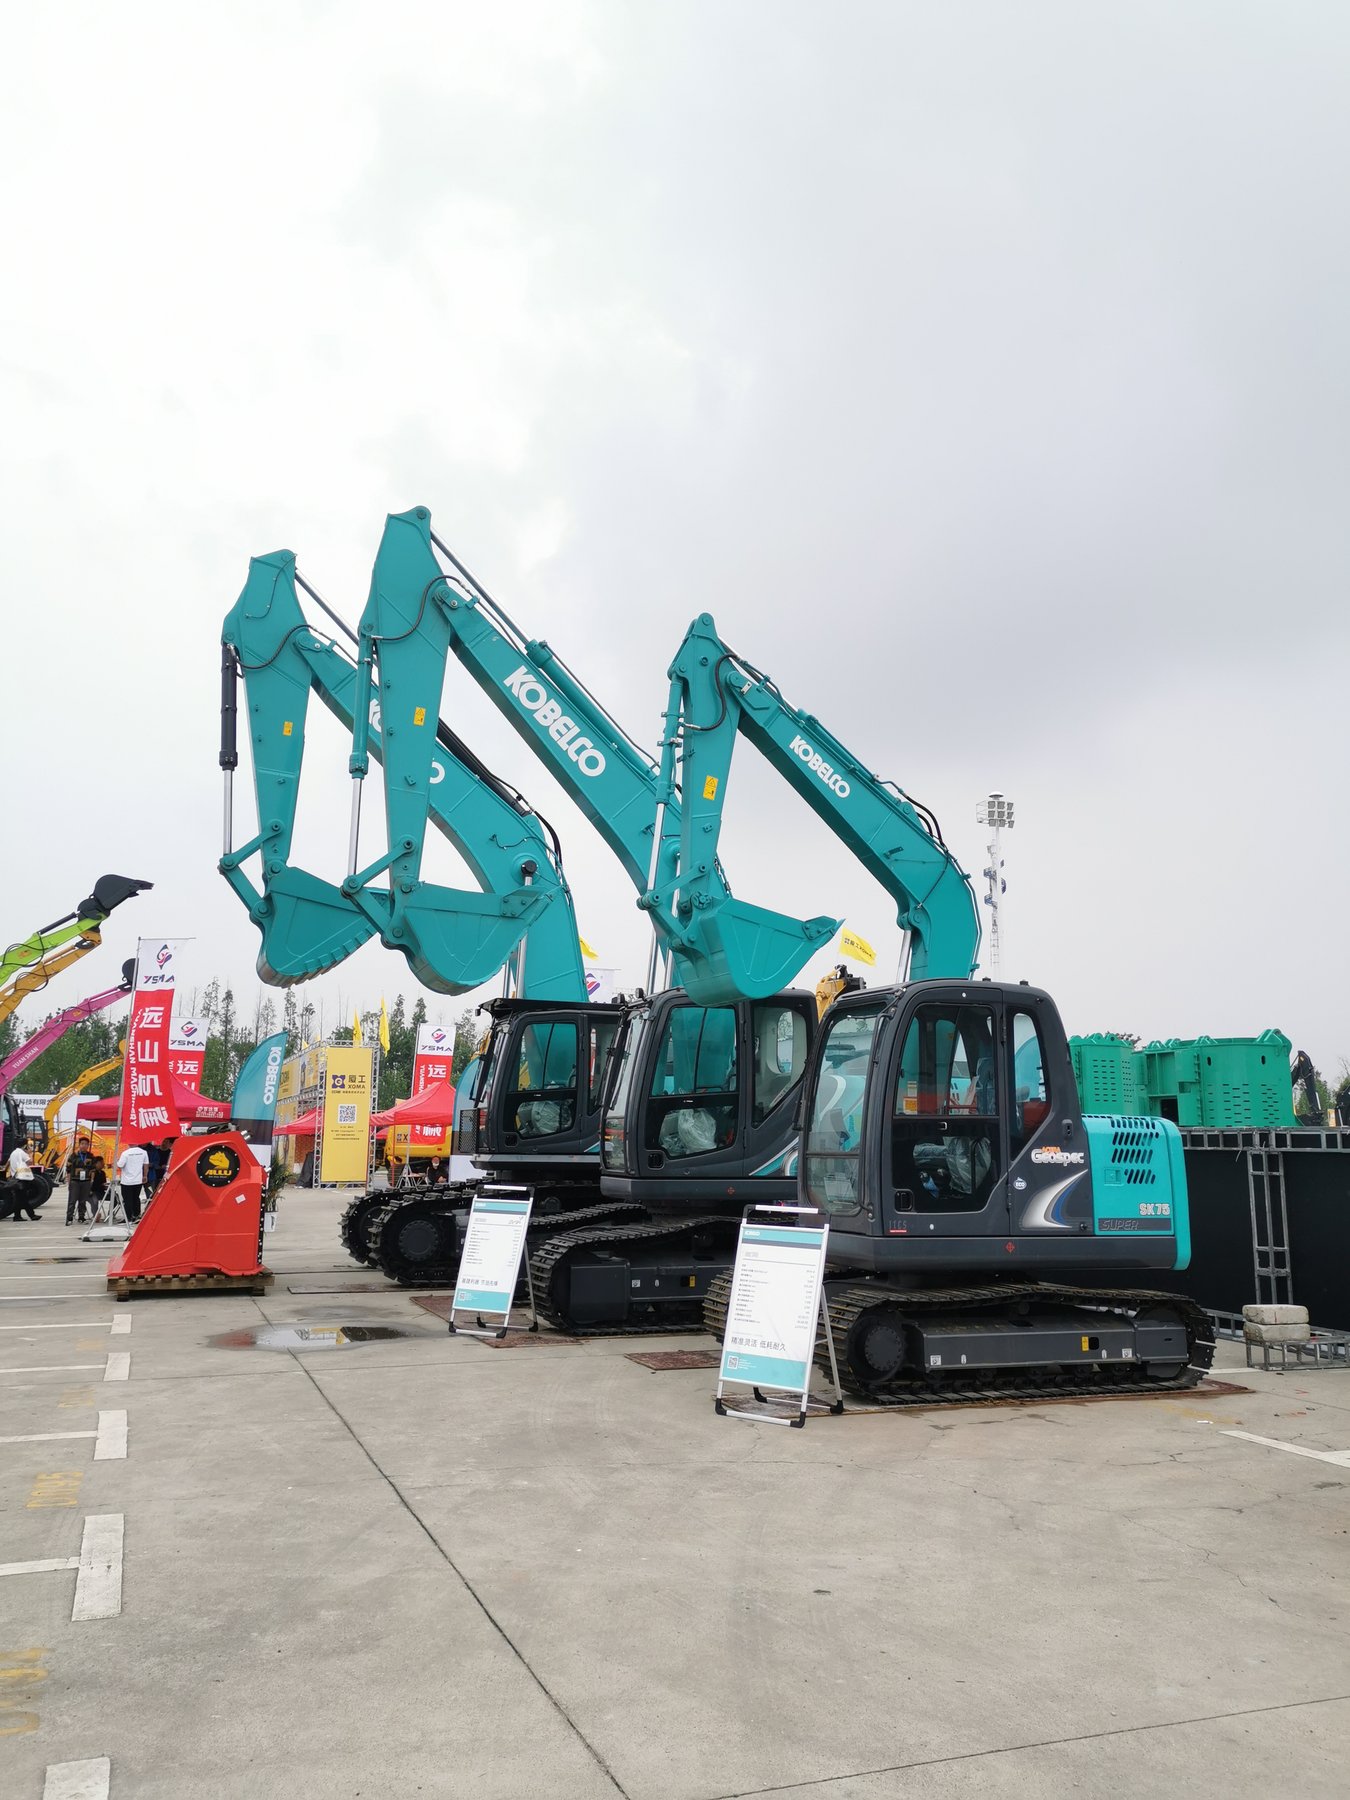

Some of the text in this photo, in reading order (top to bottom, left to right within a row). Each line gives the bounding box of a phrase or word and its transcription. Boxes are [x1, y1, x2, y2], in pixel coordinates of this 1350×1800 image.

[503, 665, 606, 777] KOBELCO
[789, 735, 851, 798] KOBELCO
[170, 1039, 205, 1047] YSMA
[421, 1044, 453, 1052] YSMA
[137, 1006, 171, 1129] 远山机械
[263, 1046, 283, 1105] KOBELCO
[1031, 1148, 1085, 1166] Geospec
[1101, 1220, 1140, 1231] SUPER
[731, 1336, 786, 1352] 精准灵活 低耗耐久
